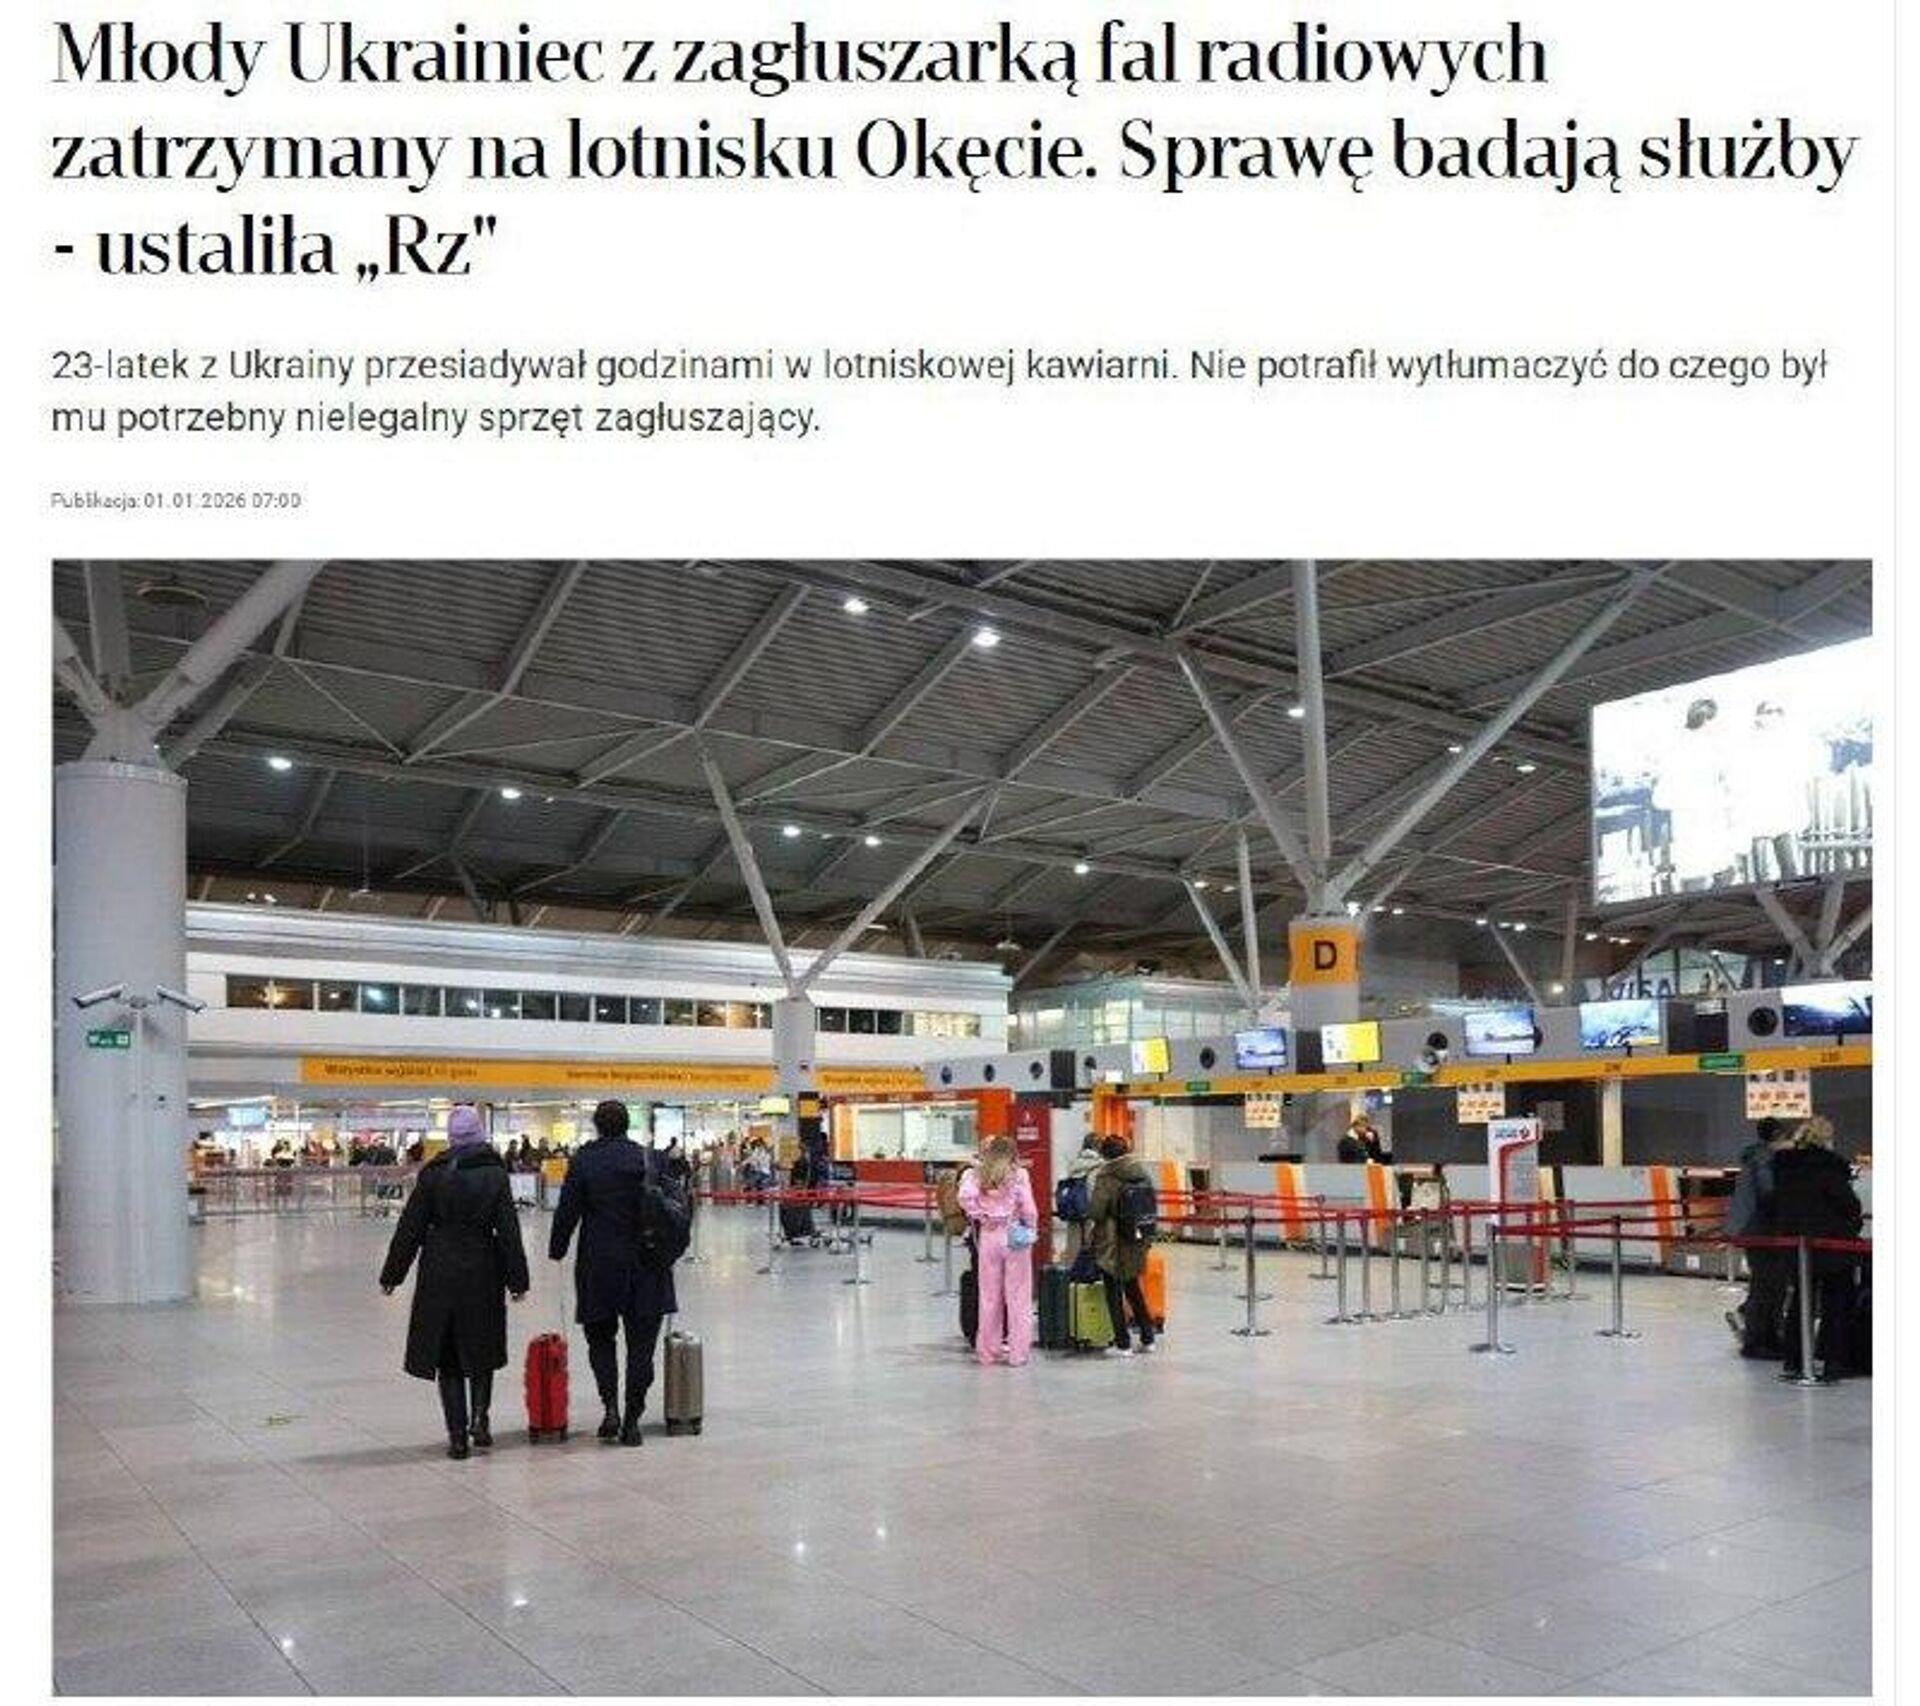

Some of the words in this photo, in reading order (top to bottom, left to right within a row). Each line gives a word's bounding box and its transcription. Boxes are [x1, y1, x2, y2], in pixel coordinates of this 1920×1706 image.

[54, 22, 267, 97] Młody
[285, 22, 604, 82] Ukrainiec
[623, 41, 656, 82] z
[674, 22, 1078, 97] zagłuszarką
[1097, 19, 1179, 82] fal
[1198, 22, 1548, 97] radiowych
[53, 126, 451, 193] zatrzymany
[469, 137, 548, 178] na
[568, 118, 836, 178] lotnisku
[858, 118, 1096, 193] Okęcie.
[1122, 118, 1373, 193] Sprawę
[1393, 118, 1621, 193] badają
[1641, 118, 1860, 193] służby
[55, 245, 73, 253] -
[97, 214, 337, 275] ustaliła
[357, 214, 496, 283] „Rz"
[53, 349, 189, 378] 23-latek
[201, 356, 217, 378] z
[231, 349, 354, 386] Ukrainy
[366, 349, 587, 387] przesiadywał
[597, 349, 772, 387] godzinami
[786, 356, 811, 378] w
[825, 349, 1013, 387] lotniskowej
[1028, 348, 1178, 379] kawiarni.
[1192, 349, 1246, 378] Nie
[1258, 349, 1376, 387] potrafił
[1387, 348, 1607, 387] wytłumaczyć
[1618, 348, 1659, 378] do
[1670, 356, 1770, 387] czego
[1783, 349, 1827, 387] był
[53, 408, 105, 431] mu
[118, 401, 285, 438] potrzebny
[297, 401, 467, 438] nielegalny
[480, 405, 583, 438] sprzęt
[596, 401, 819, 438] zagłuszający.
[52, 493, 139, 511] Publikacja:
[145, 493, 245, 508] 01.01.2026
[253, 493, 301, 508] 07:00
[1314, 939, 1338, 971] D
